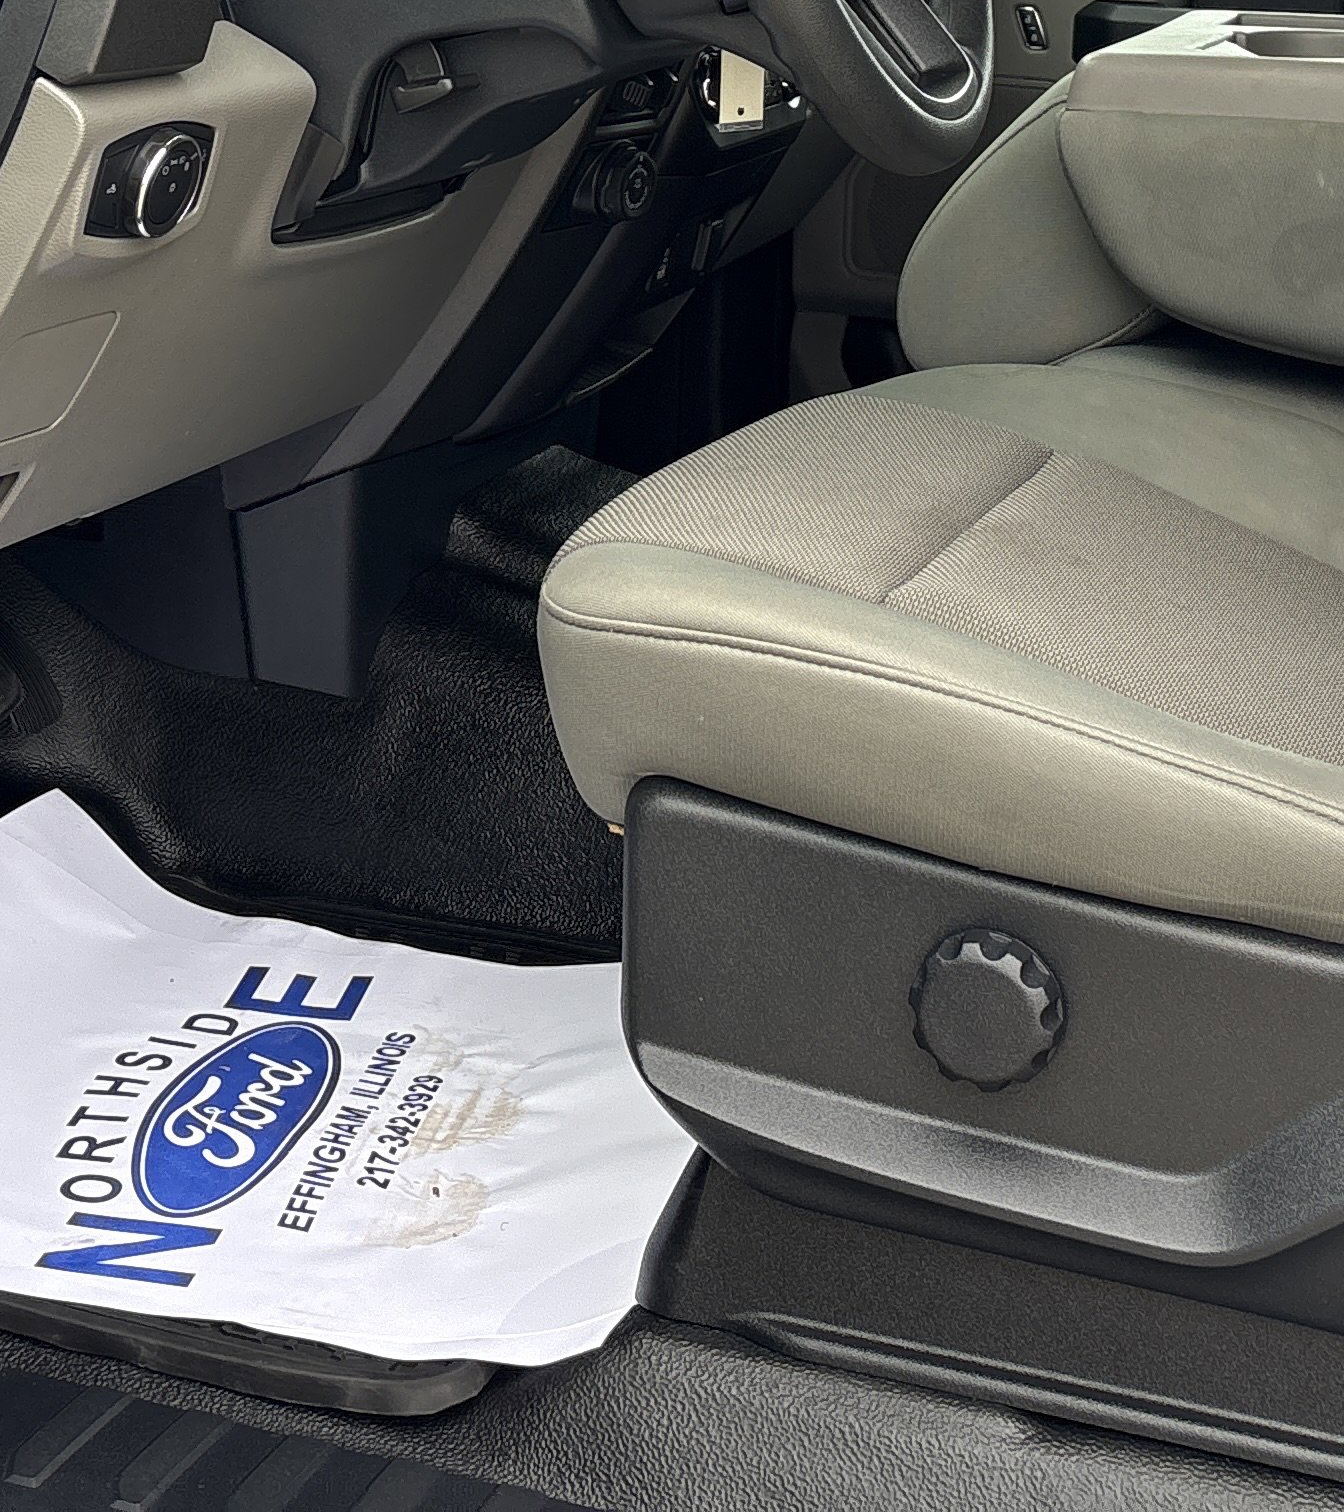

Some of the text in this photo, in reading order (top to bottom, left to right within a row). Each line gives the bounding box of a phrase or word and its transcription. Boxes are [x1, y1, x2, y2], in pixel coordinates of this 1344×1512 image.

[35, 966, 374, 1287] NORTHSIDE
[162, 1053, 314, 1169] Ford
[277, 1032, 416, 1233] EFFINGHAM, ILLINOIS
[356, 1074, 443, 1190] 217-342-3929
